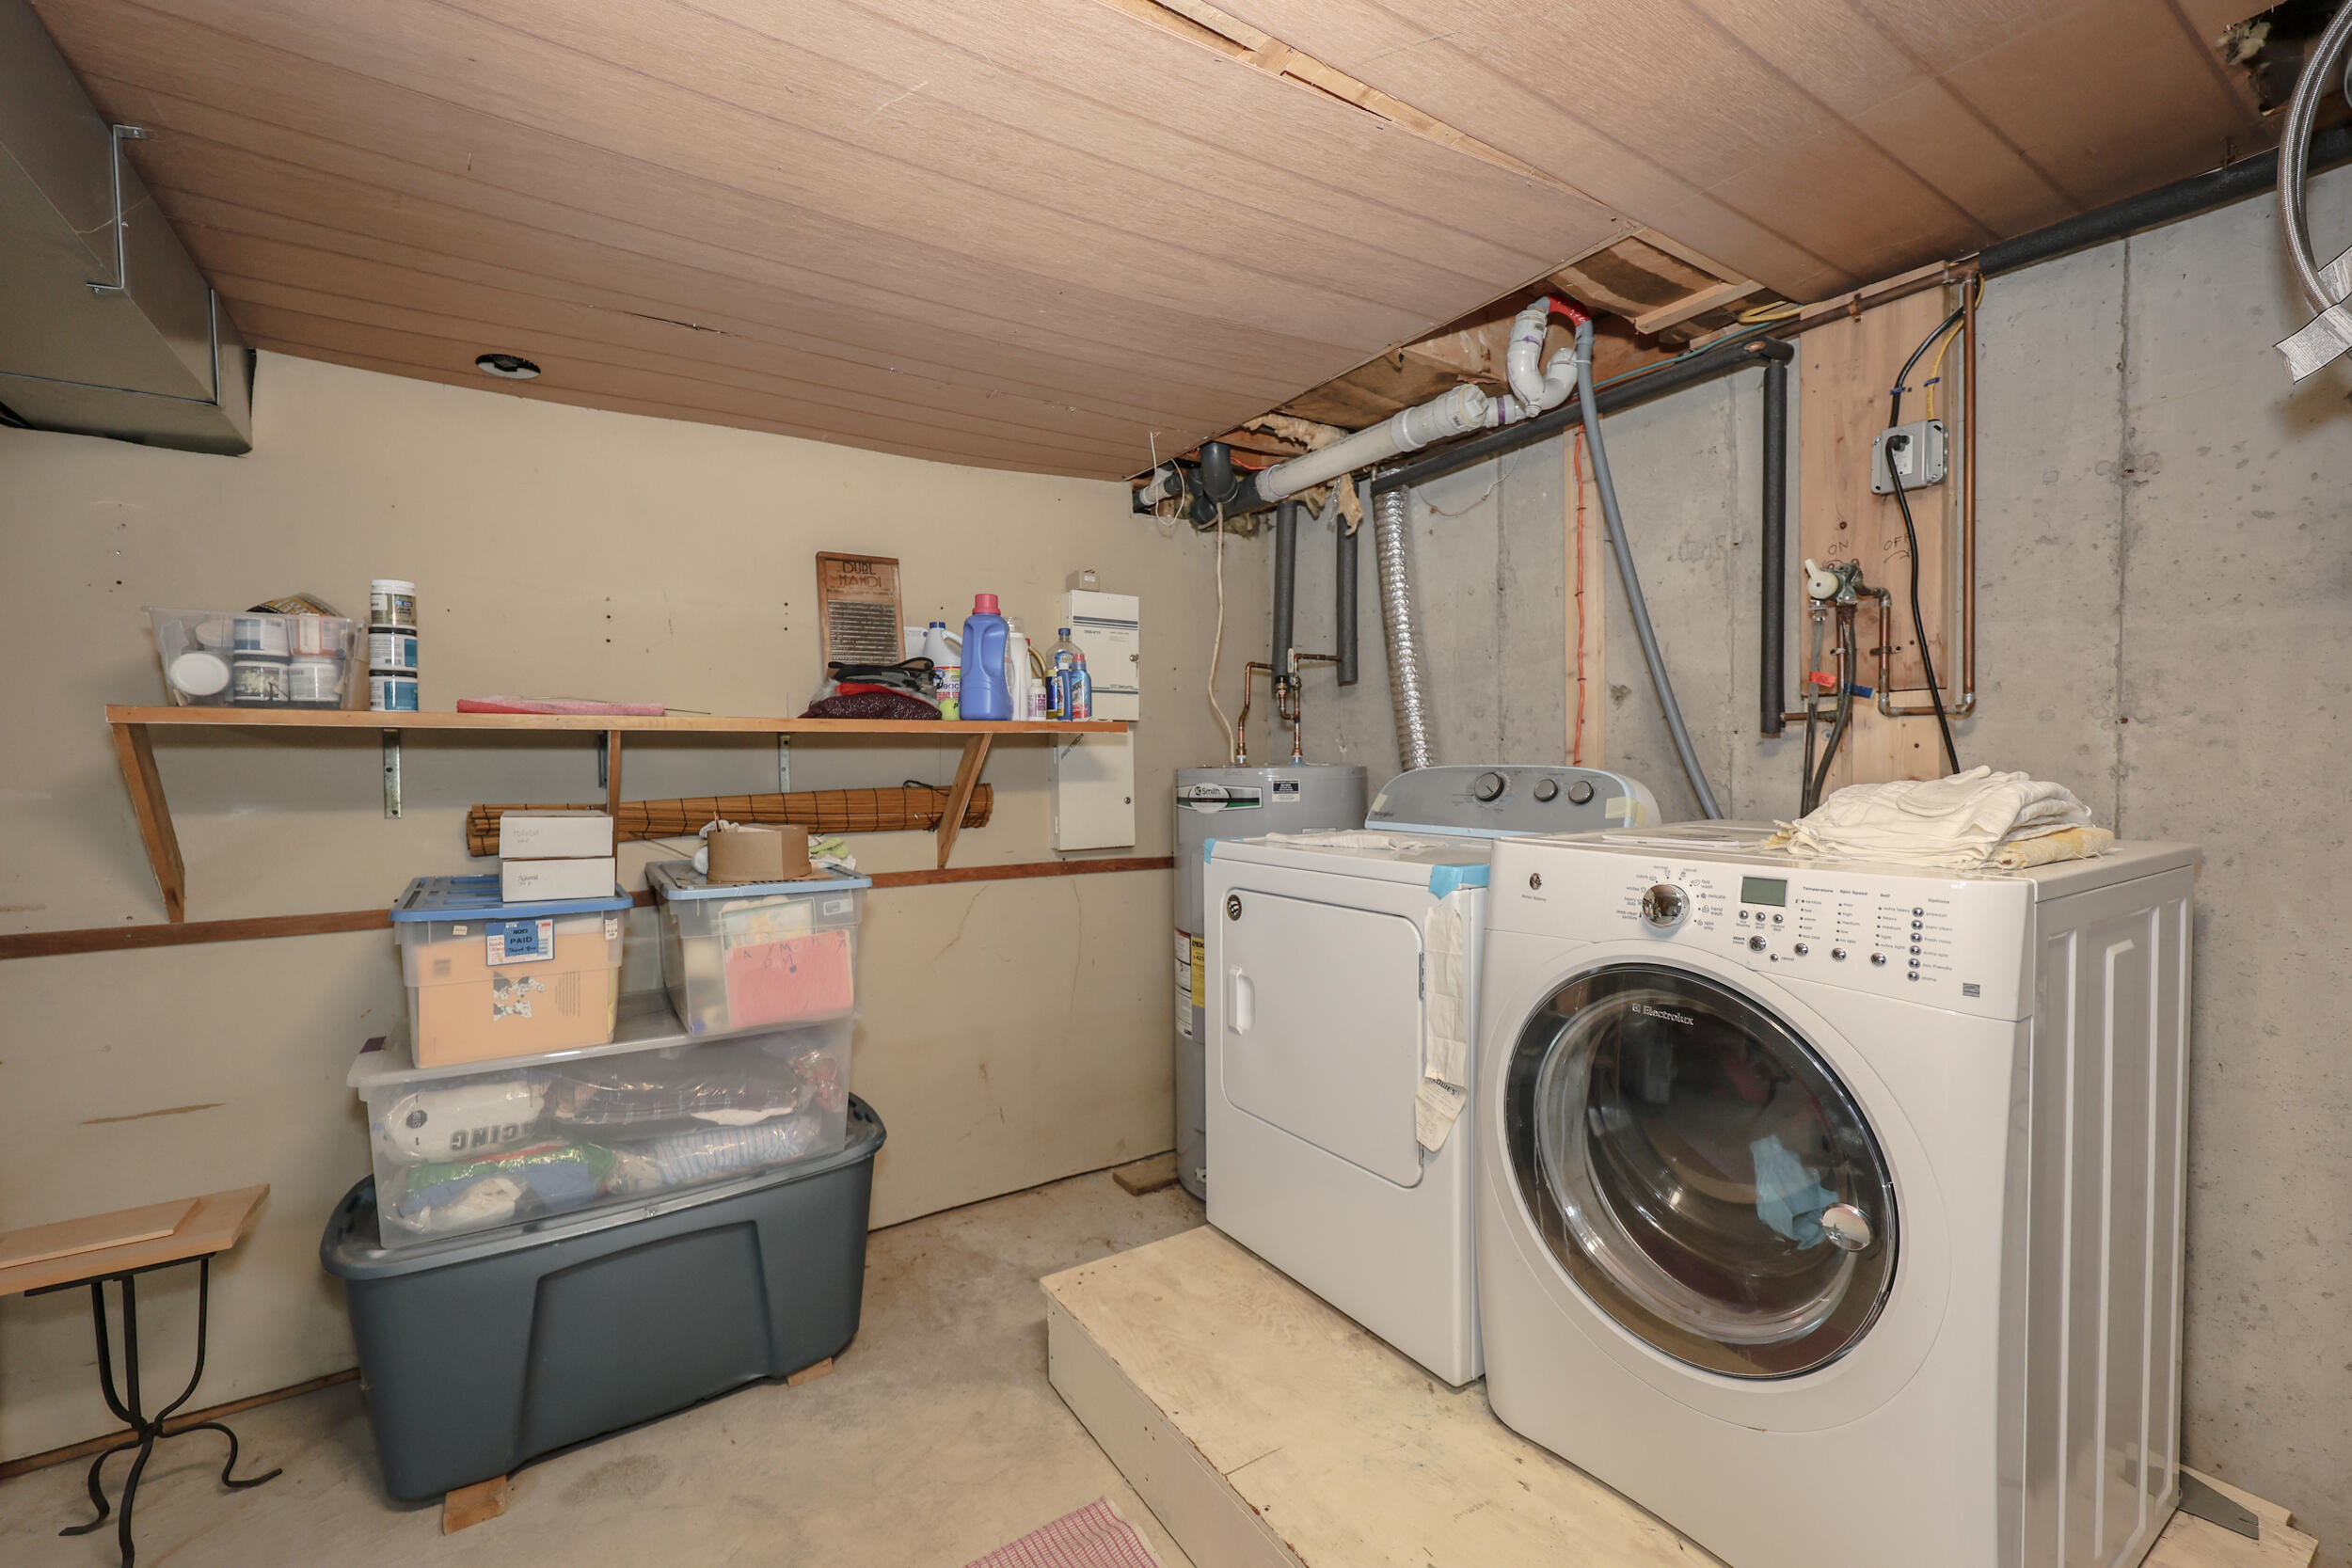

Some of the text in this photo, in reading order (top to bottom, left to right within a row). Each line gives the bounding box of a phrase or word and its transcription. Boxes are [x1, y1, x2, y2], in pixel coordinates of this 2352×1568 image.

[1827, 540, 1850, 555] ON
[1201, 787, 1220, 796] Smith
[509, 936, 533, 945] PAID
[1643, 1004, 1694, 1026] Electrolux
